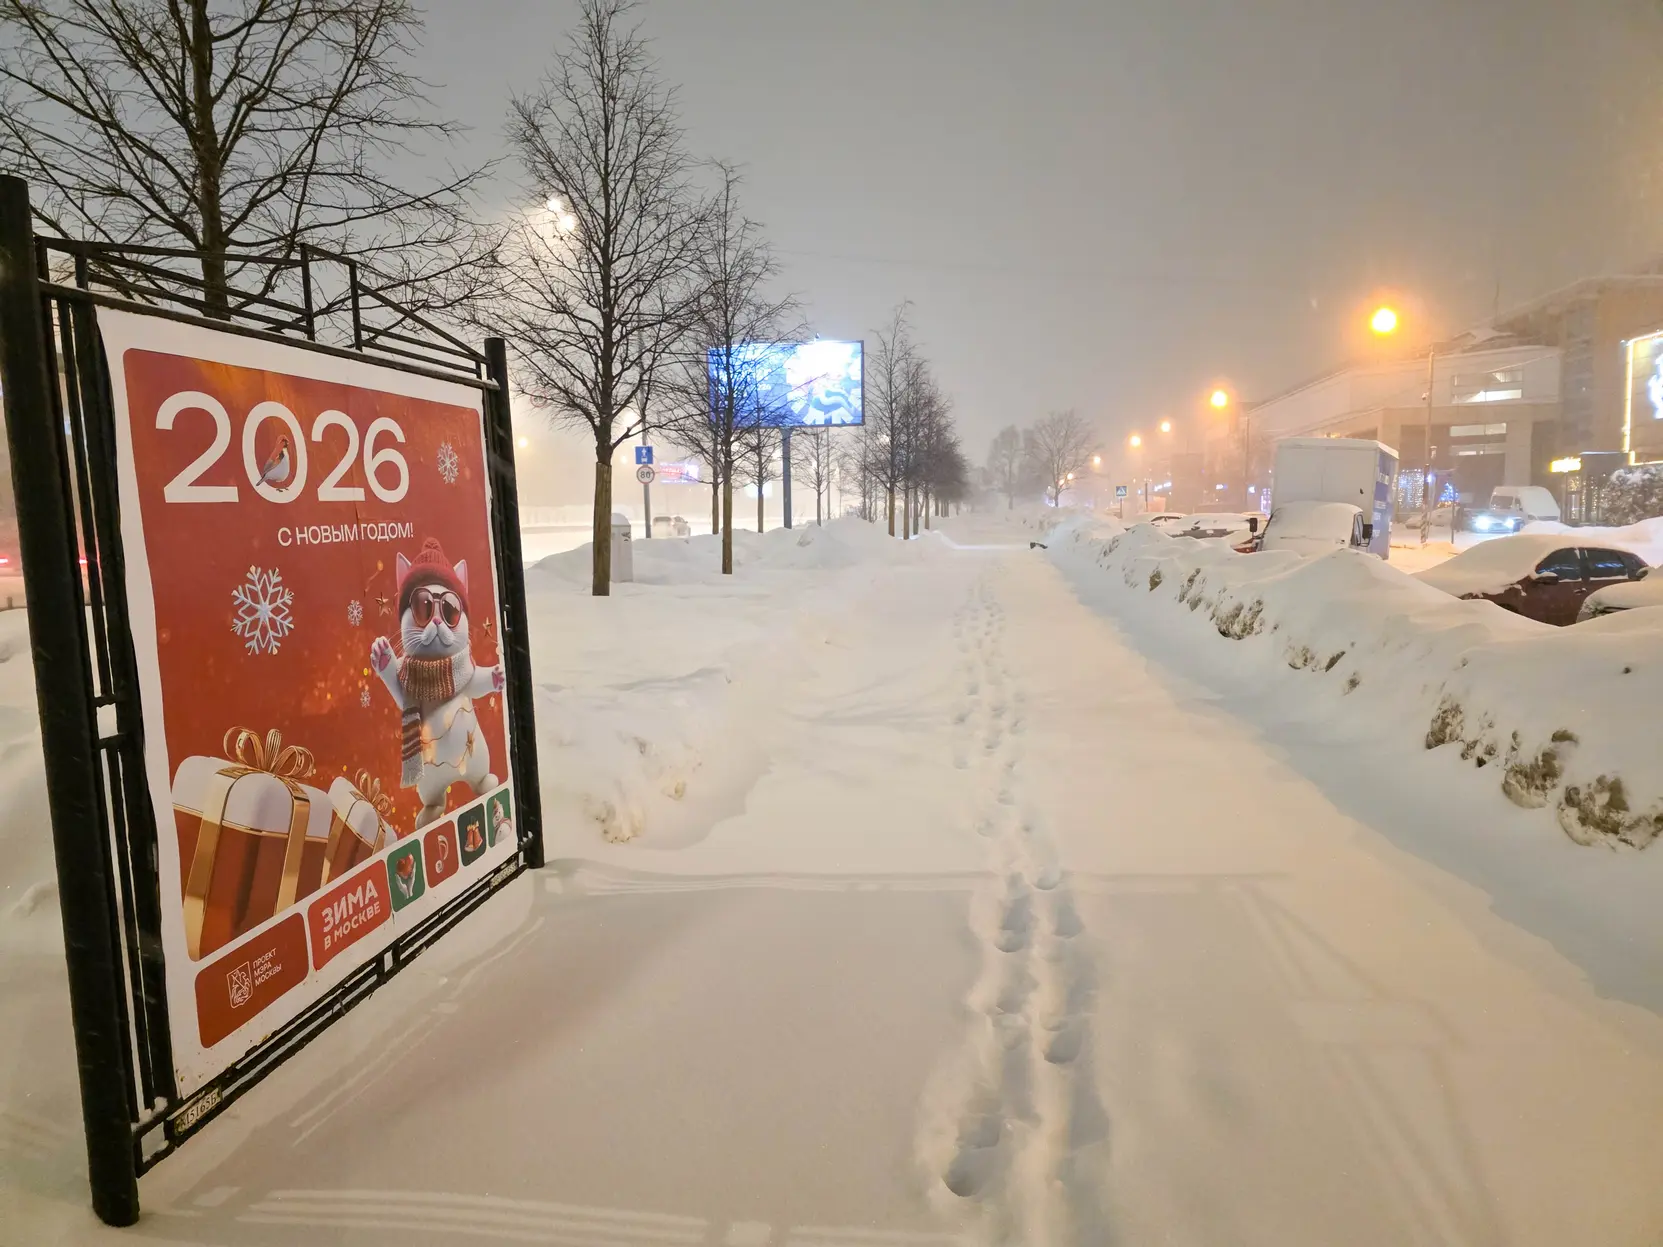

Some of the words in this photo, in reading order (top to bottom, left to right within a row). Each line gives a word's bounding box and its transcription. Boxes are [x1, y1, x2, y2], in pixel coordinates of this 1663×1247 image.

[155, 390, 410, 503] 2026
[640, 470, 651, 479] 80
[277, 527, 292, 547] С
[295, 523, 359, 545] НОВЫМ
[360, 522, 415, 542] ГОДОМ!
[321, 879, 379, 933] ЗИМА
[324, 934, 332, 951] В
[334, 901, 381, 942] МОСКВЕ
[252, 947, 277, 969] ПРОЕКТ
[254, 961, 272, 978] МЭРА
[255, 963, 282, 987] МОСКВЫ
